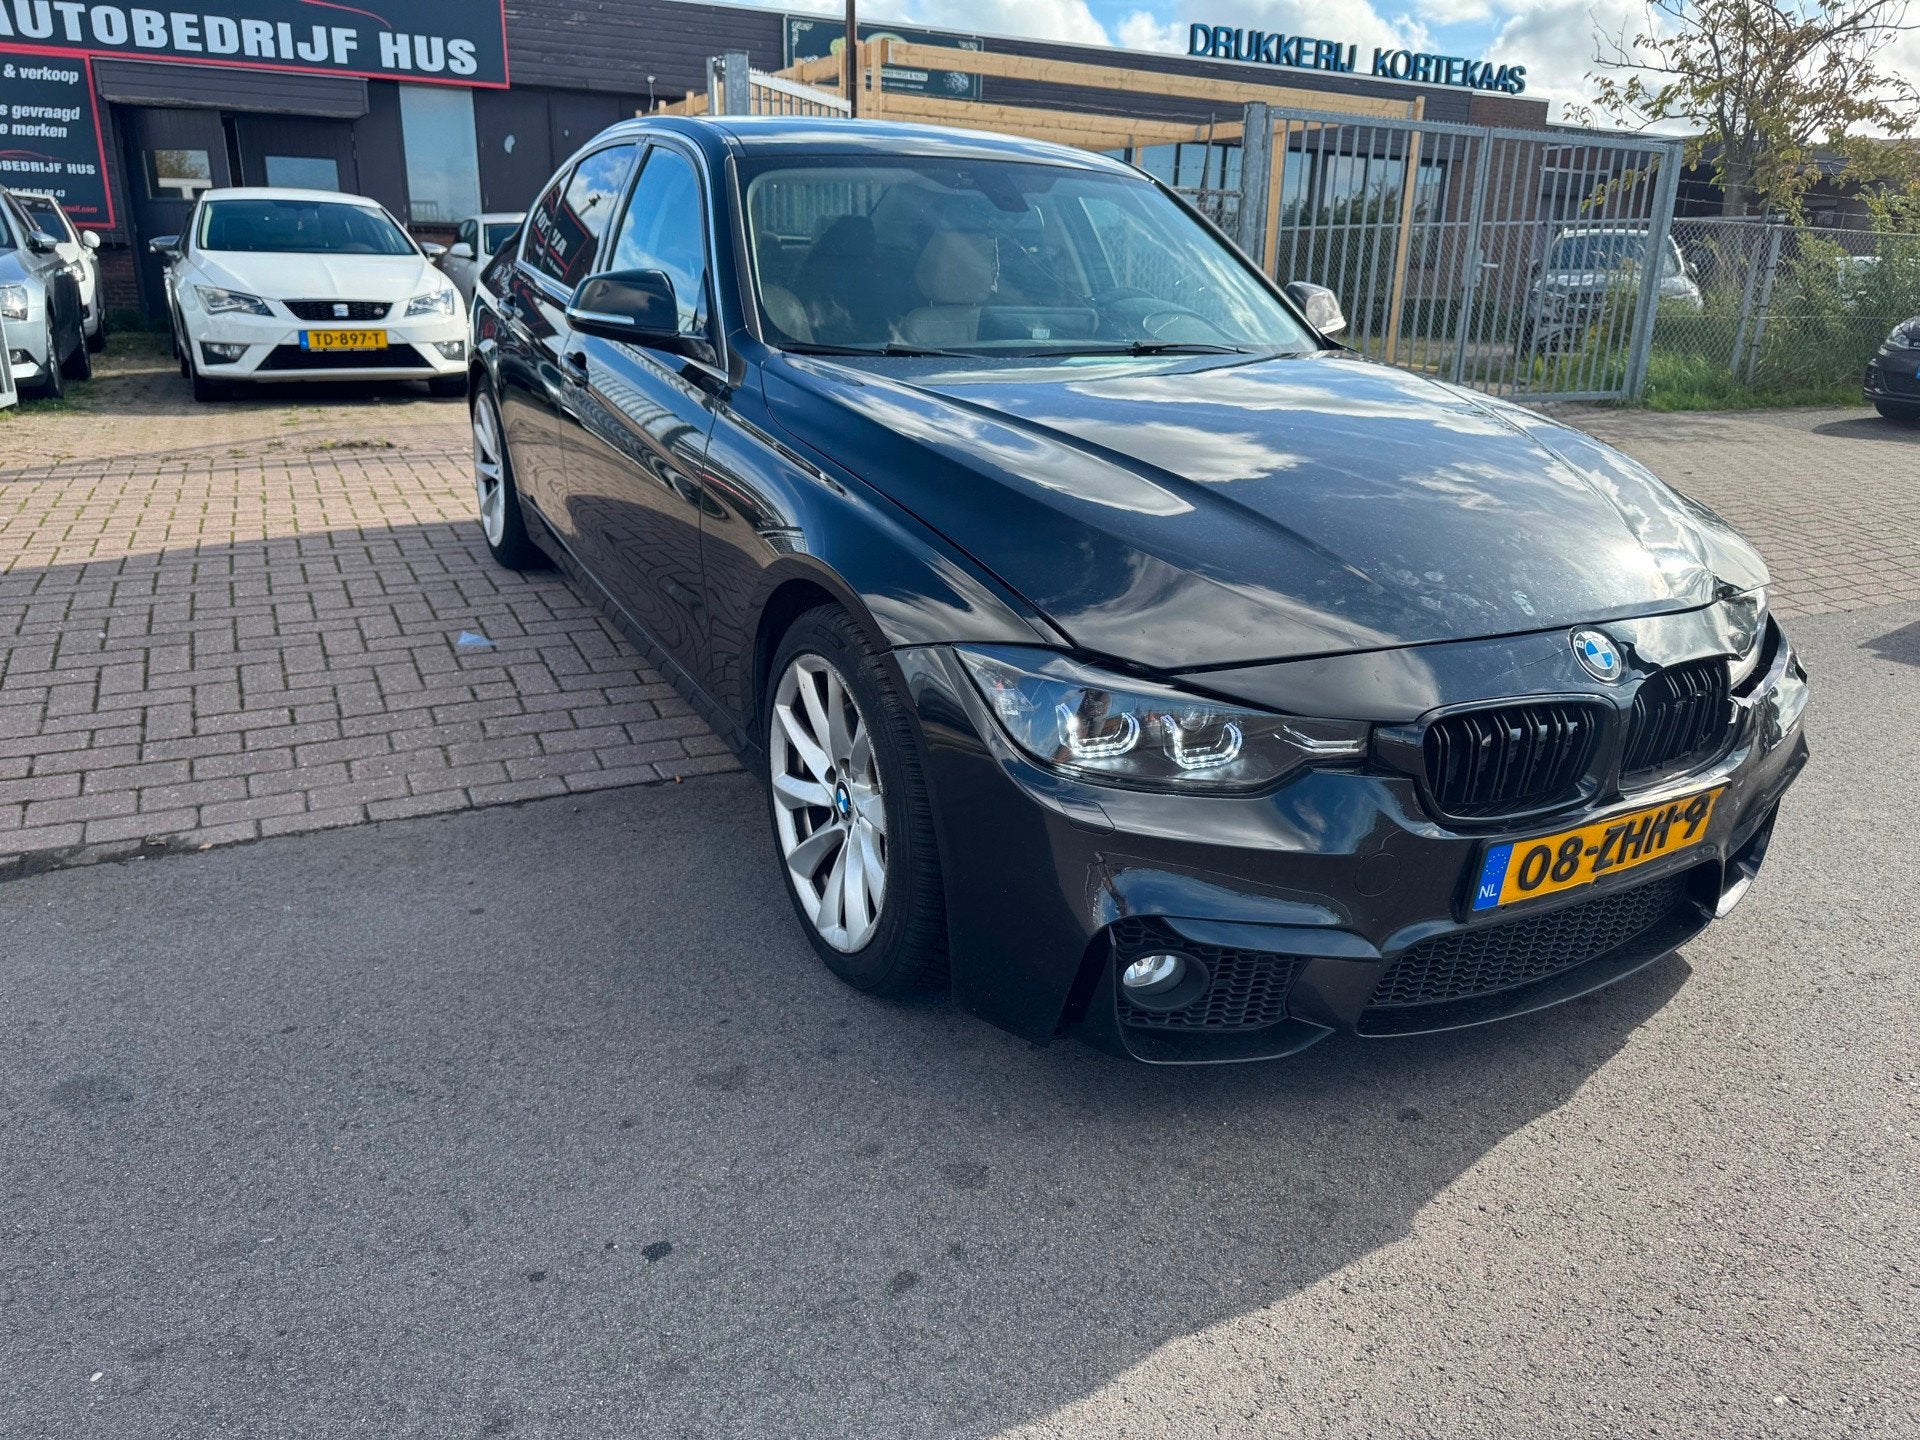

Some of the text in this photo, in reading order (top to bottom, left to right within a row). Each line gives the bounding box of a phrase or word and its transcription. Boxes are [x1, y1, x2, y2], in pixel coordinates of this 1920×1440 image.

[379, 32, 478, 75] HUS
[1188, 22, 1527, 95] DRUKKERIJ KORTEKAAS
[3, 63, 79, 85] & verkoop
[12, 105, 80, 122] gevraagd
[12, 123, 67, 138] merken
[0, 160, 96, 175] BEDRIJF HUS
[313, 332, 380, 346] TD-897-T
[1518, 794, 1710, 891] 08-ZHH-9
[1479, 884, 1497, 900] NL
